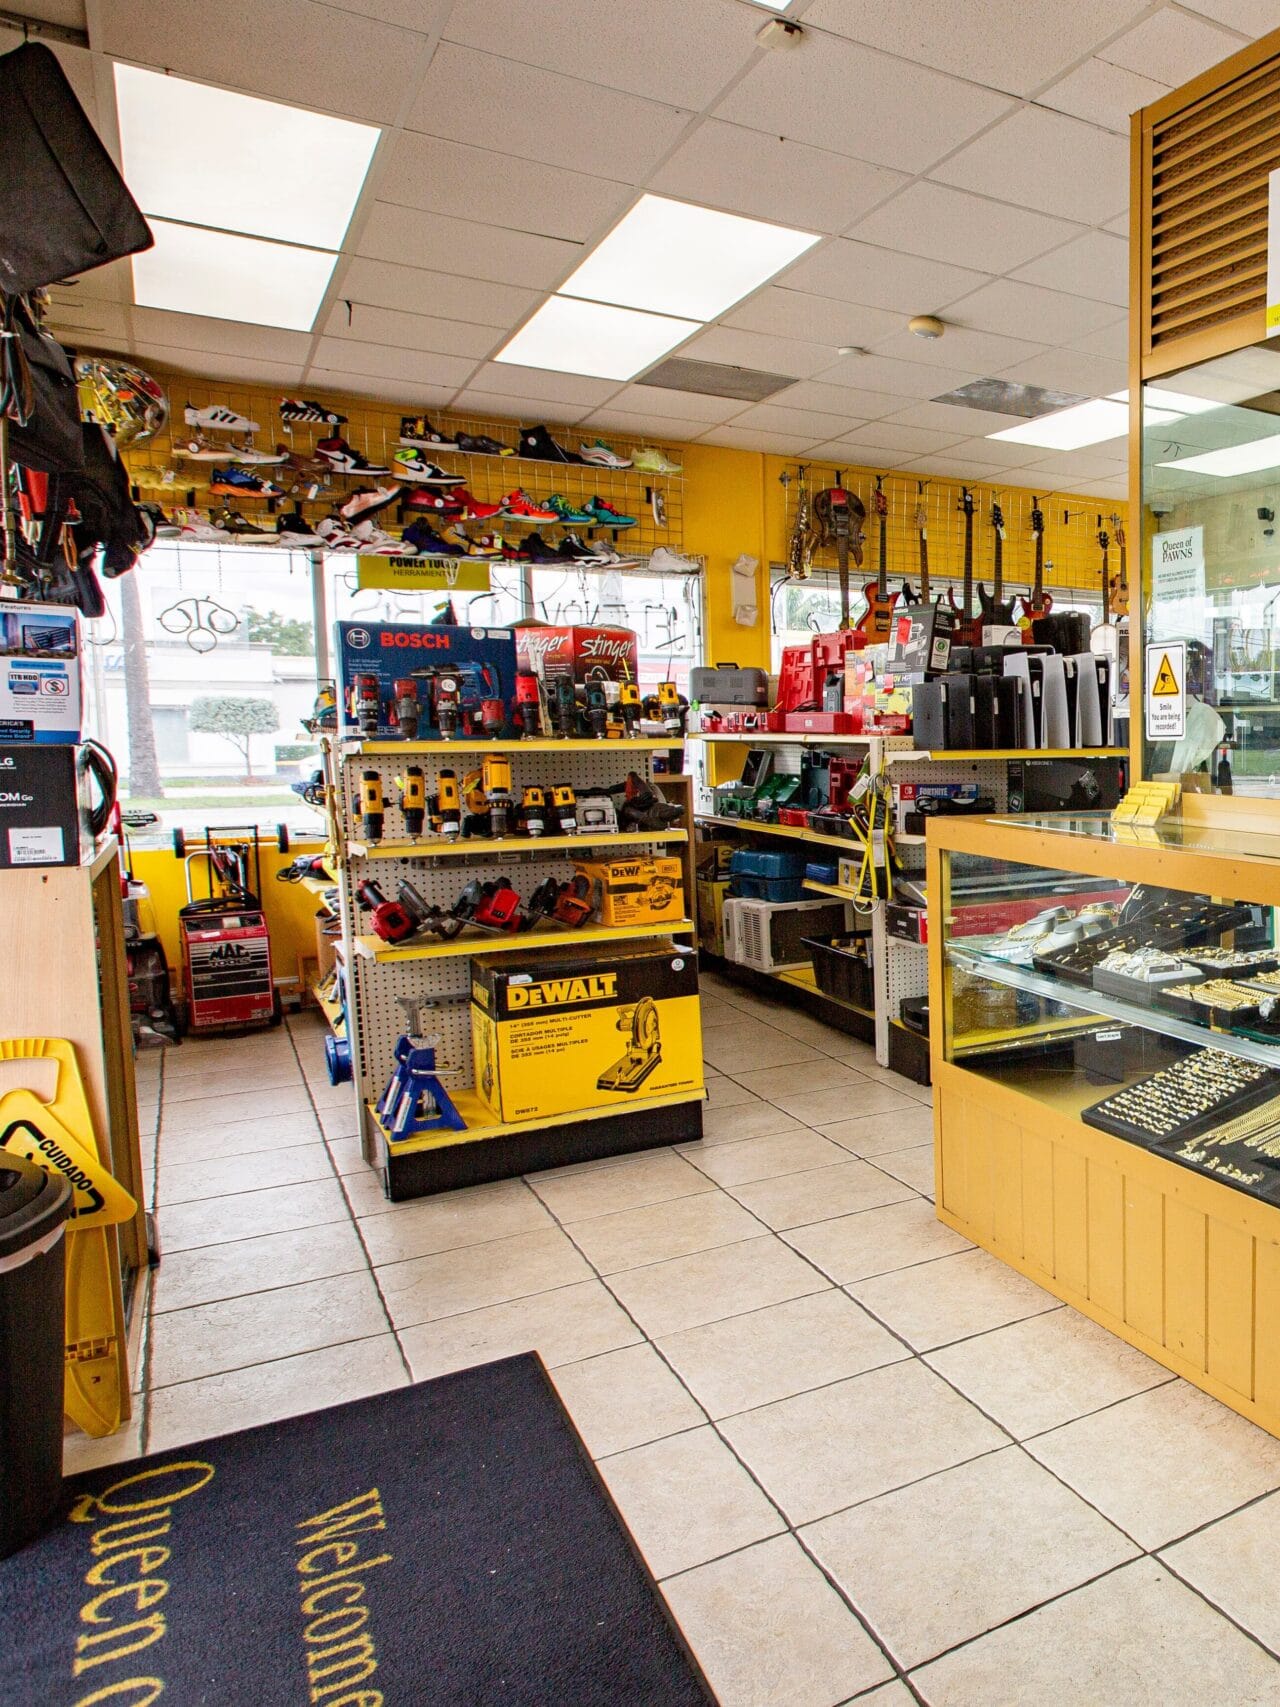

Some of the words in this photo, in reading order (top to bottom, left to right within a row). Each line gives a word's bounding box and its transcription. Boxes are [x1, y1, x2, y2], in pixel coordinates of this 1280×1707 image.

[1162, 540, 1184, 552] Queen
[1185, 536, 1193, 547] of
[1162, 548, 1193, 562] PAWNS
[389, 556, 426, 568] POWER
[393, 569, 456, 578] HERRAMIENT
[380, 632, 449, 649] BOSCH
[579, 634, 634, 666] stinger
[1168, 713, 1181, 722] being
[920, 787, 948, 796] FORTNITE
[209, 943, 251, 960] MAC
[209, 957, 251, 968] TOOLS
[549, 1013, 592, 1023] MULTI-CUTTER
[510, 1031, 543, 1039] CORTADOR
[544, 1026, 573, 1034] MULTIPLE
[556, 1038, 588, 1047] MULTIPLES
[38, 1139, 93, 1191] CUIDADO
[68, 1460, 215, 1677] Queen
